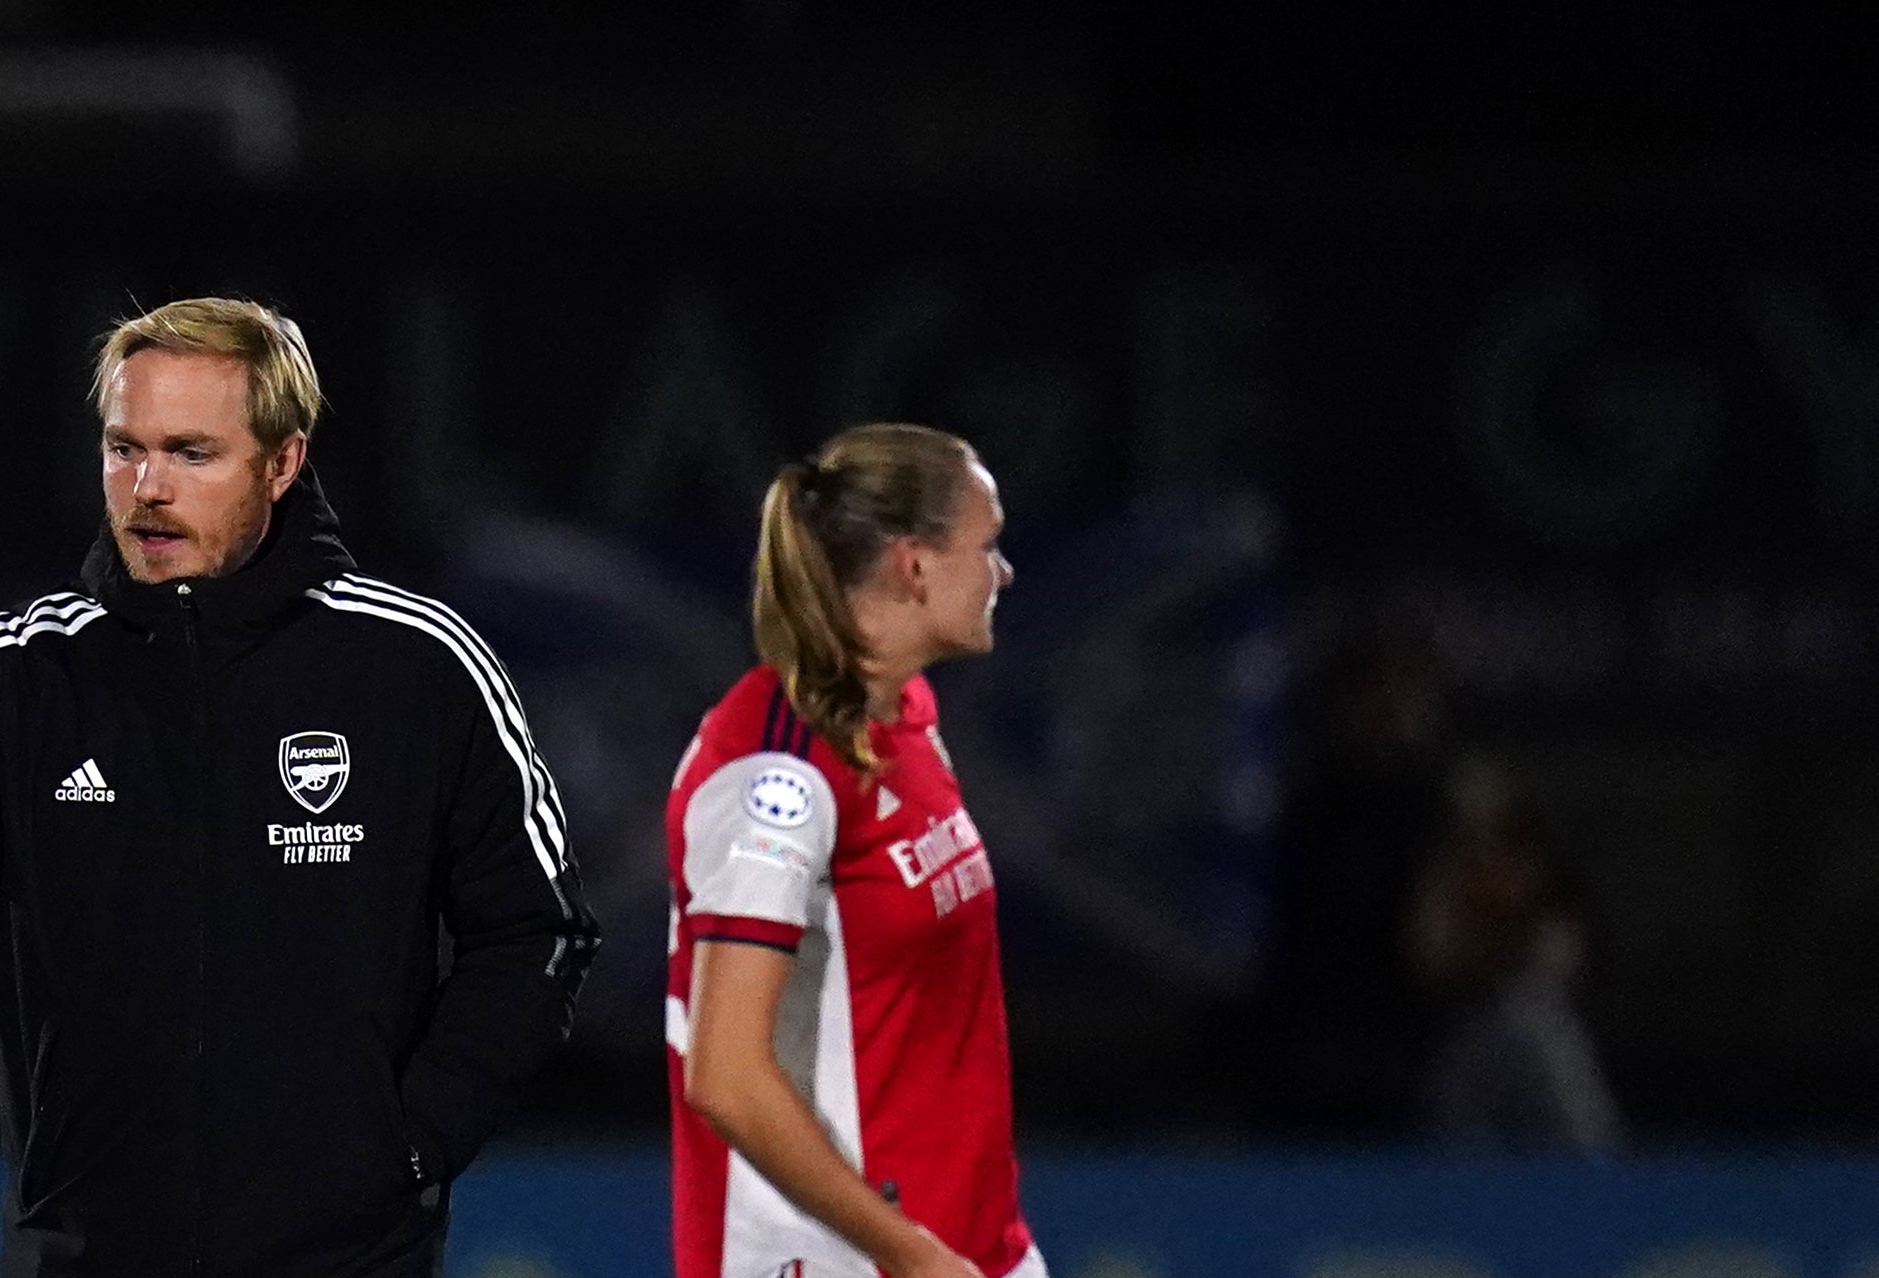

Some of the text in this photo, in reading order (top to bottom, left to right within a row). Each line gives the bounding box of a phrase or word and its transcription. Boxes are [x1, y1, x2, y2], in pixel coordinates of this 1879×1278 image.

[288, 744, 340, 760] Arsenal
[54, 785, 116, 803] adidas
[267, 821, 365, 846] Emirates
[283, 844, 352, 864] FLY BETTER
